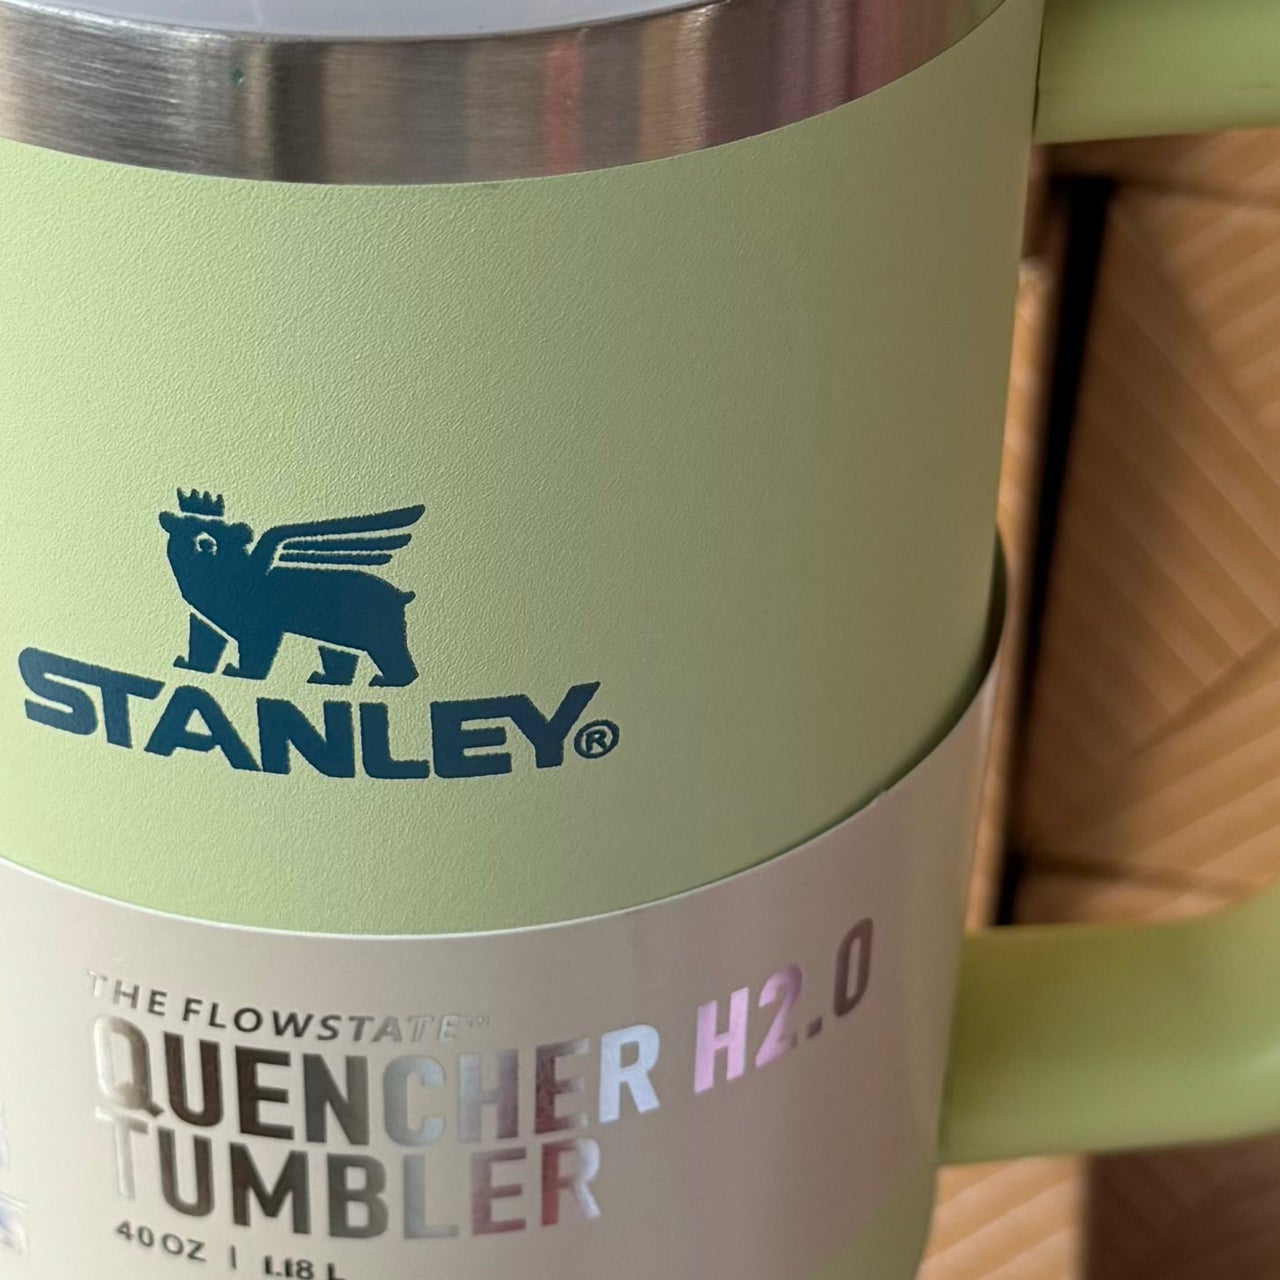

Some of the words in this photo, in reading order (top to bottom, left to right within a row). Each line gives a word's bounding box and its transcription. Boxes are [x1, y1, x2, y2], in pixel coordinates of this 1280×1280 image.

[87, 968, 168, 1017] THE
[92, 1015, 660, 1148] QUENCHER
[693, 916, 874, 1094] H2.0
[94, 1105, 601, 1240] TUMBLER
